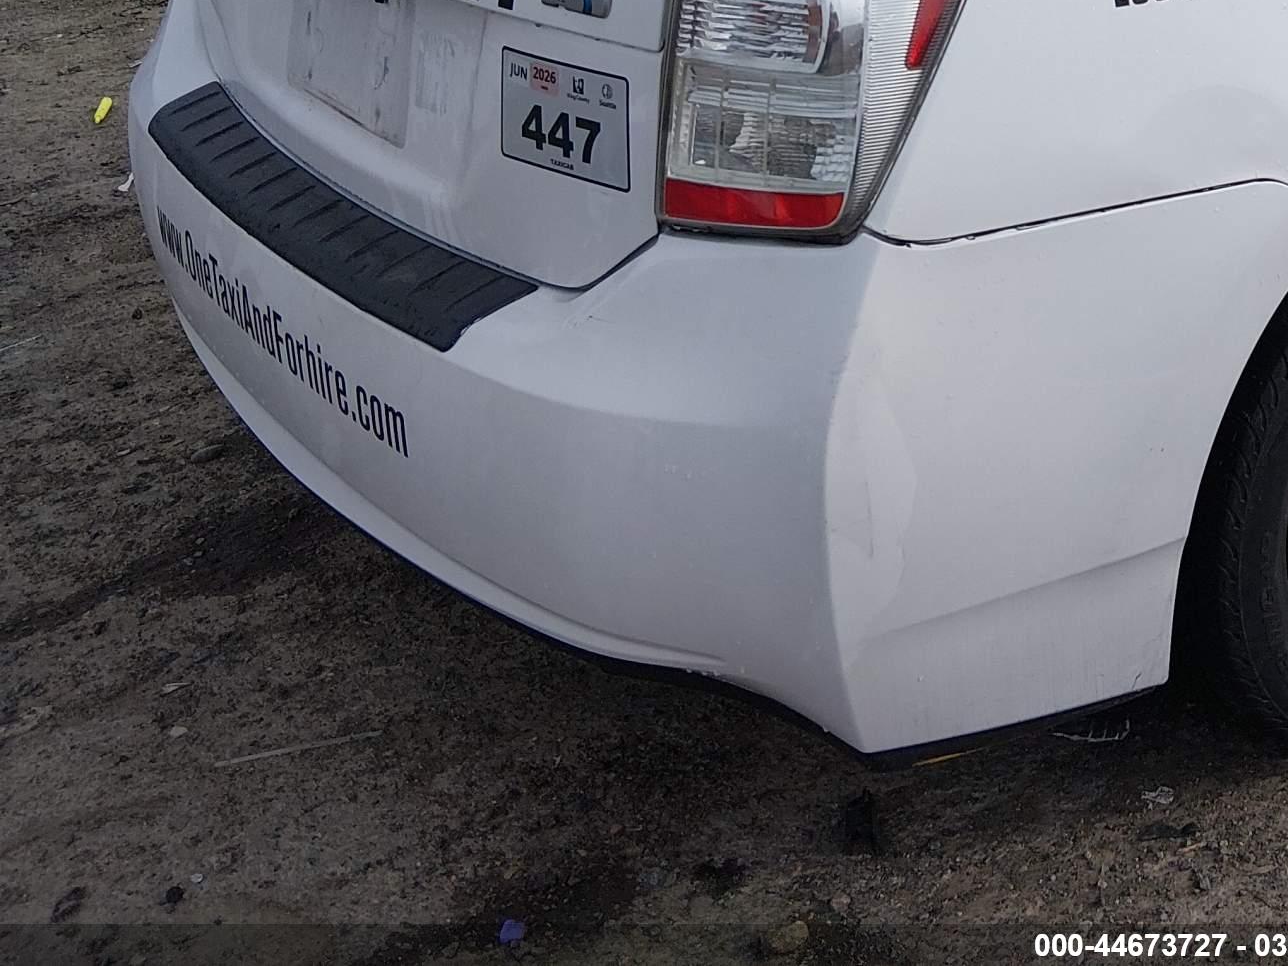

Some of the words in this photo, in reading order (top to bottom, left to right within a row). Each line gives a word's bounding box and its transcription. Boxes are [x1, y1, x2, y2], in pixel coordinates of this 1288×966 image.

[509, 62, 528, 81] JUN
[533, 67, 557, 84] 2026
[521, 104, 601, 164] 447
[157, 205, 409, 458] www.OneTaxiAndForhire.com
